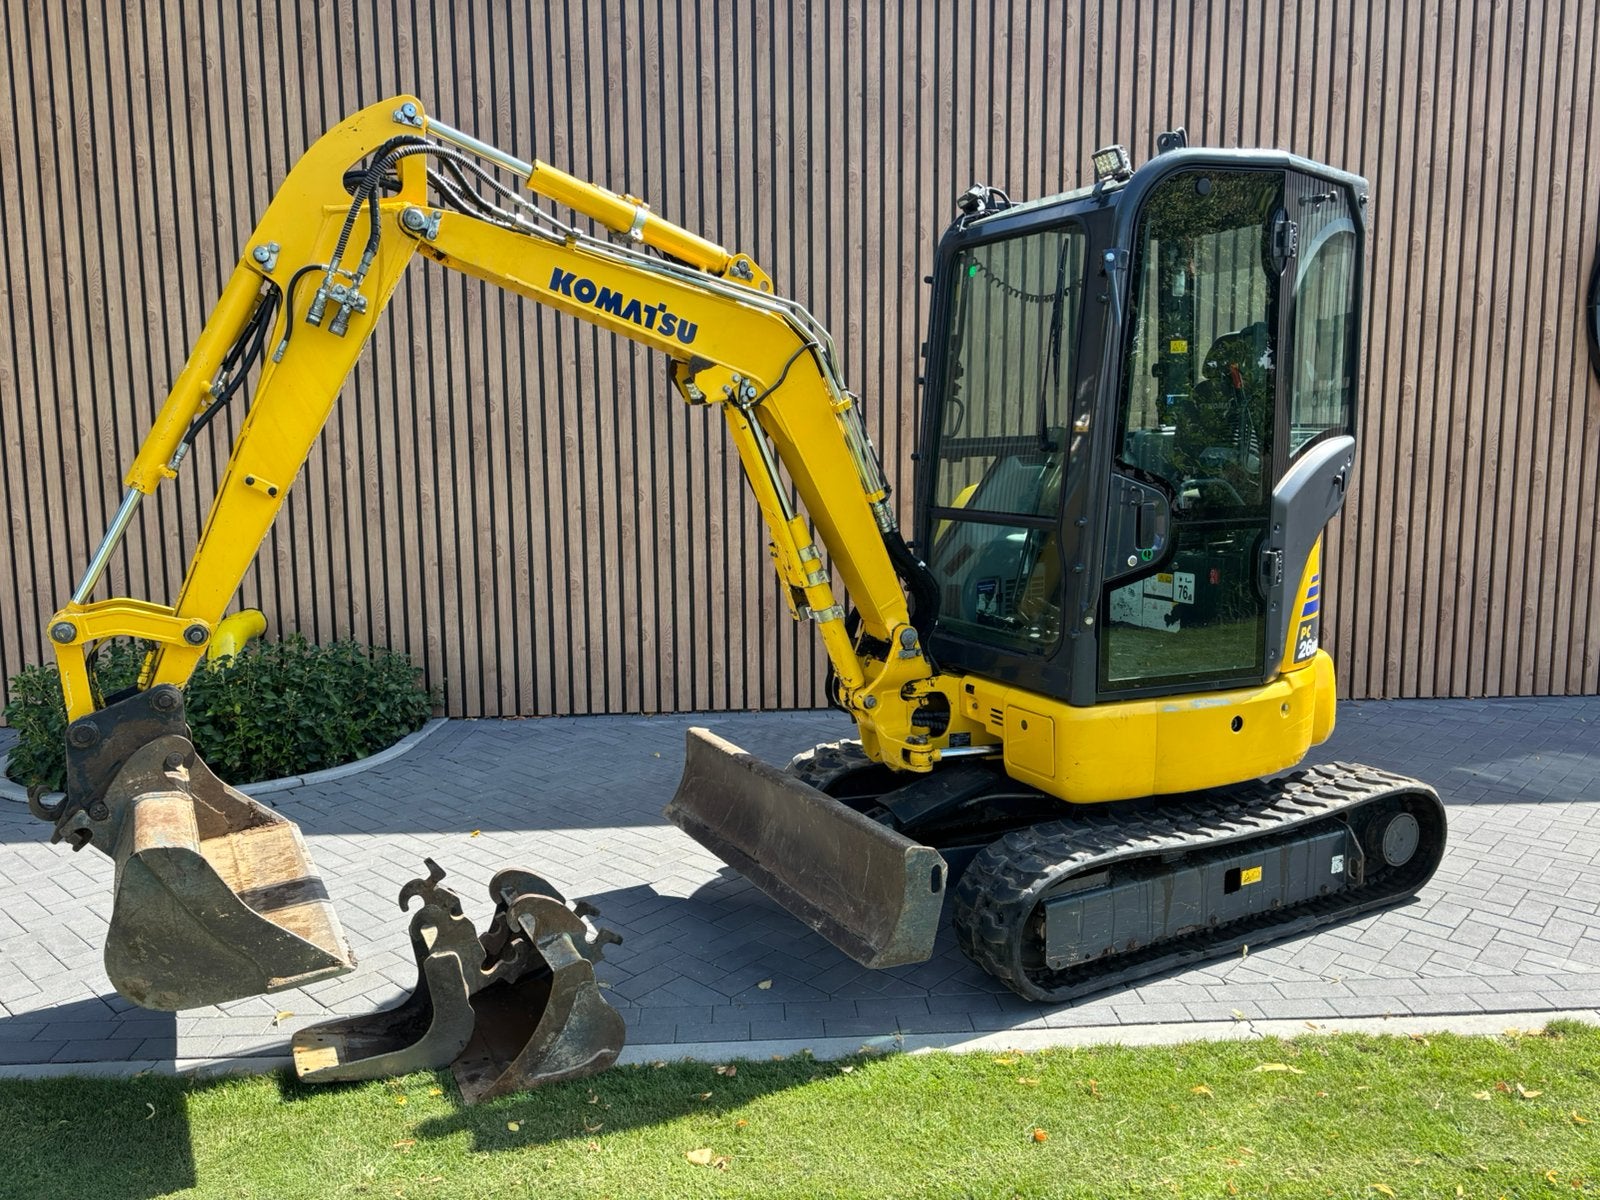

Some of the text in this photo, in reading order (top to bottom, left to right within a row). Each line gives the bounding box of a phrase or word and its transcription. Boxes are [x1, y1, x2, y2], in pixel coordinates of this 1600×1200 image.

[549, 267, 698, 344] KOMATSU
[1178, 585, 1189, 600] 76
[1301, 624, 1312, 640] PC
